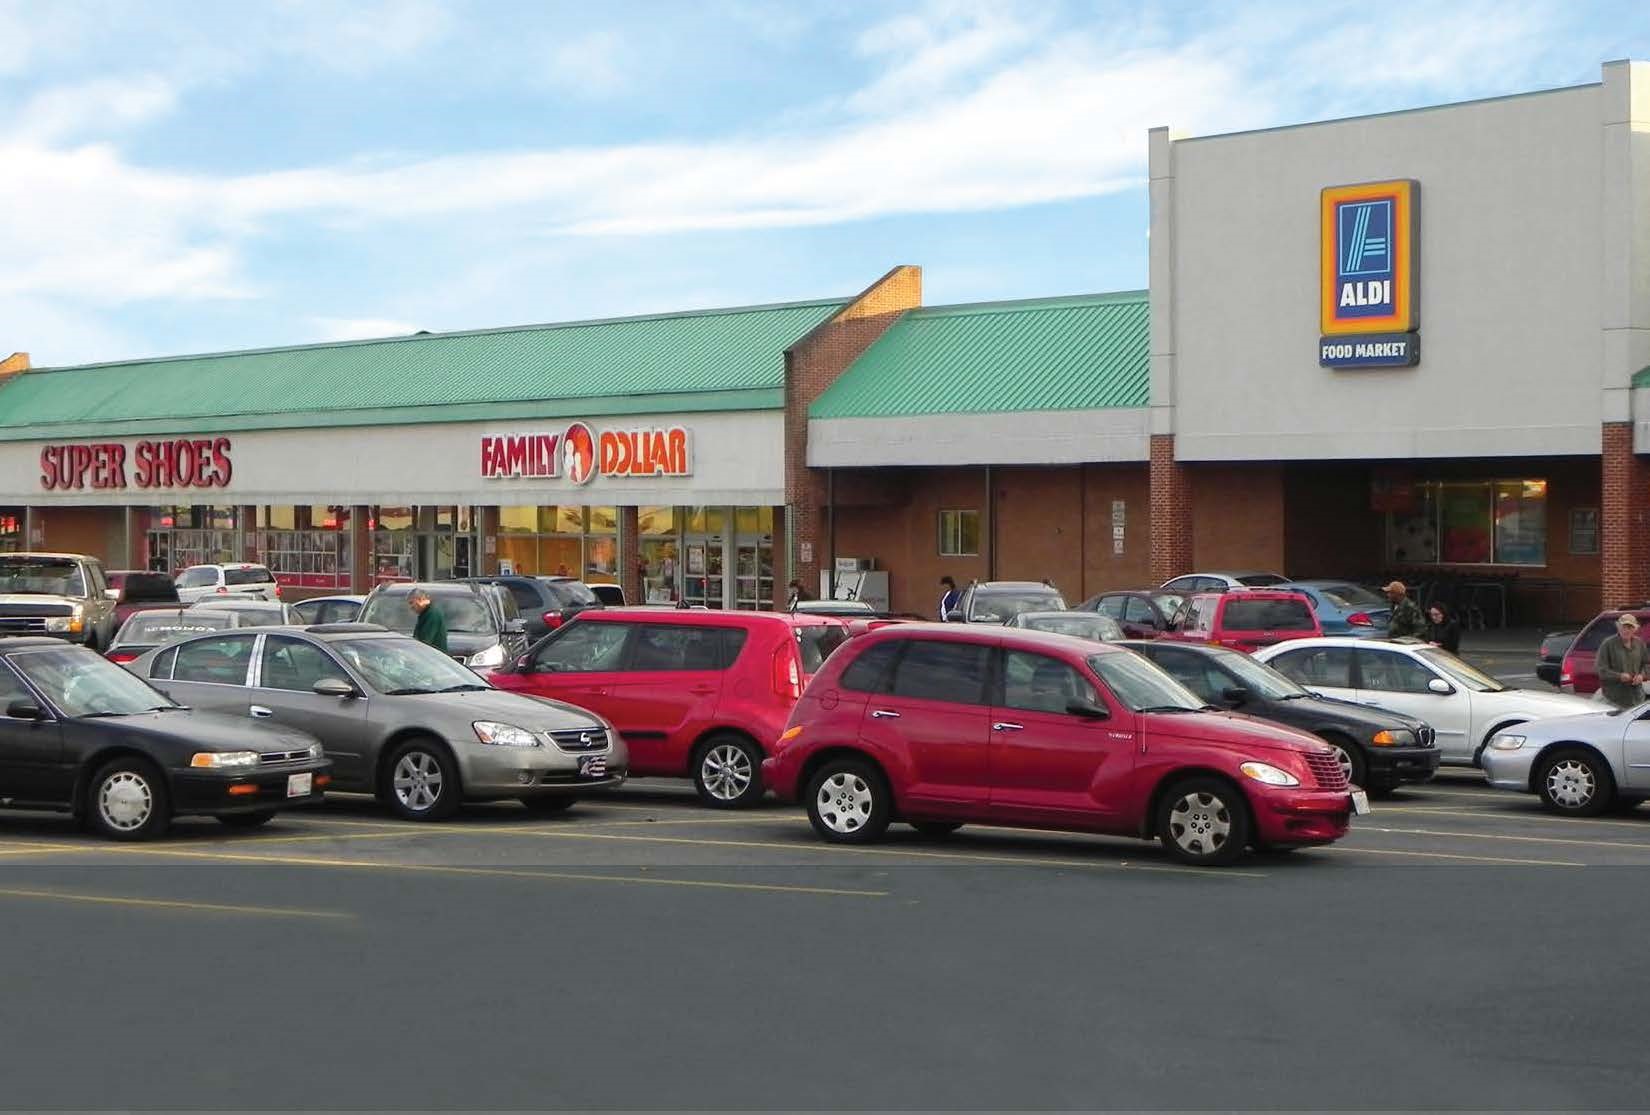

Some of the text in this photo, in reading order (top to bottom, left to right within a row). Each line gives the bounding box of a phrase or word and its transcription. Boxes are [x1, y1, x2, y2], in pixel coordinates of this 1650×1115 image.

[1340, 280, 1390, 307] ALDI
[1322, 342, 1406, 359] FOOD MARKET
[40, 437, 232, 490] SUPER SHOES
[481, 428, 686, 476] FAMILY DOLLAR
